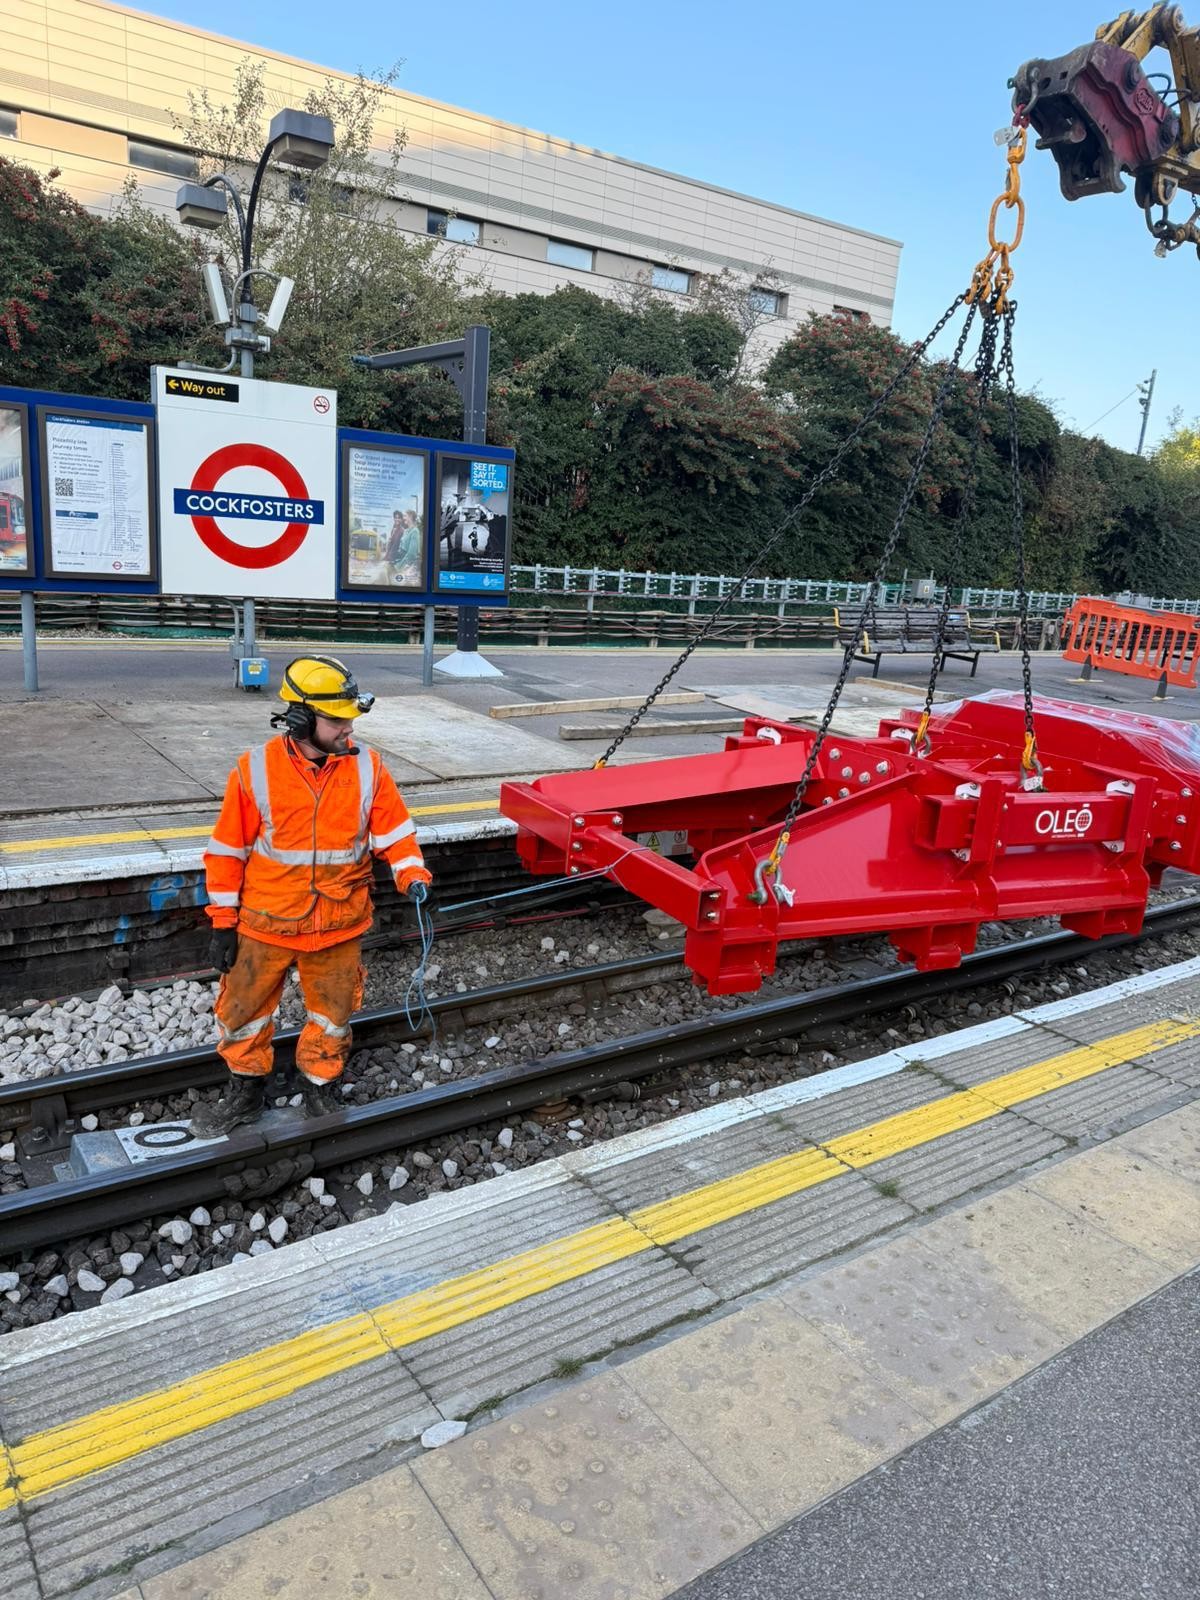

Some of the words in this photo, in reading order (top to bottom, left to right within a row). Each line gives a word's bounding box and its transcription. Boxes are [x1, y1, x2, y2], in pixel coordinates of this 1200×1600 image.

[180, 380, 205, 395] Way
[206, 386, 226, 396] out
[473, 462, 487, 471] SEE
[472, 470, 488, 479] SAY
[472, 479, 506, 489] SORTED.
[186, 495, 314, 519] COCKFOSTERS
